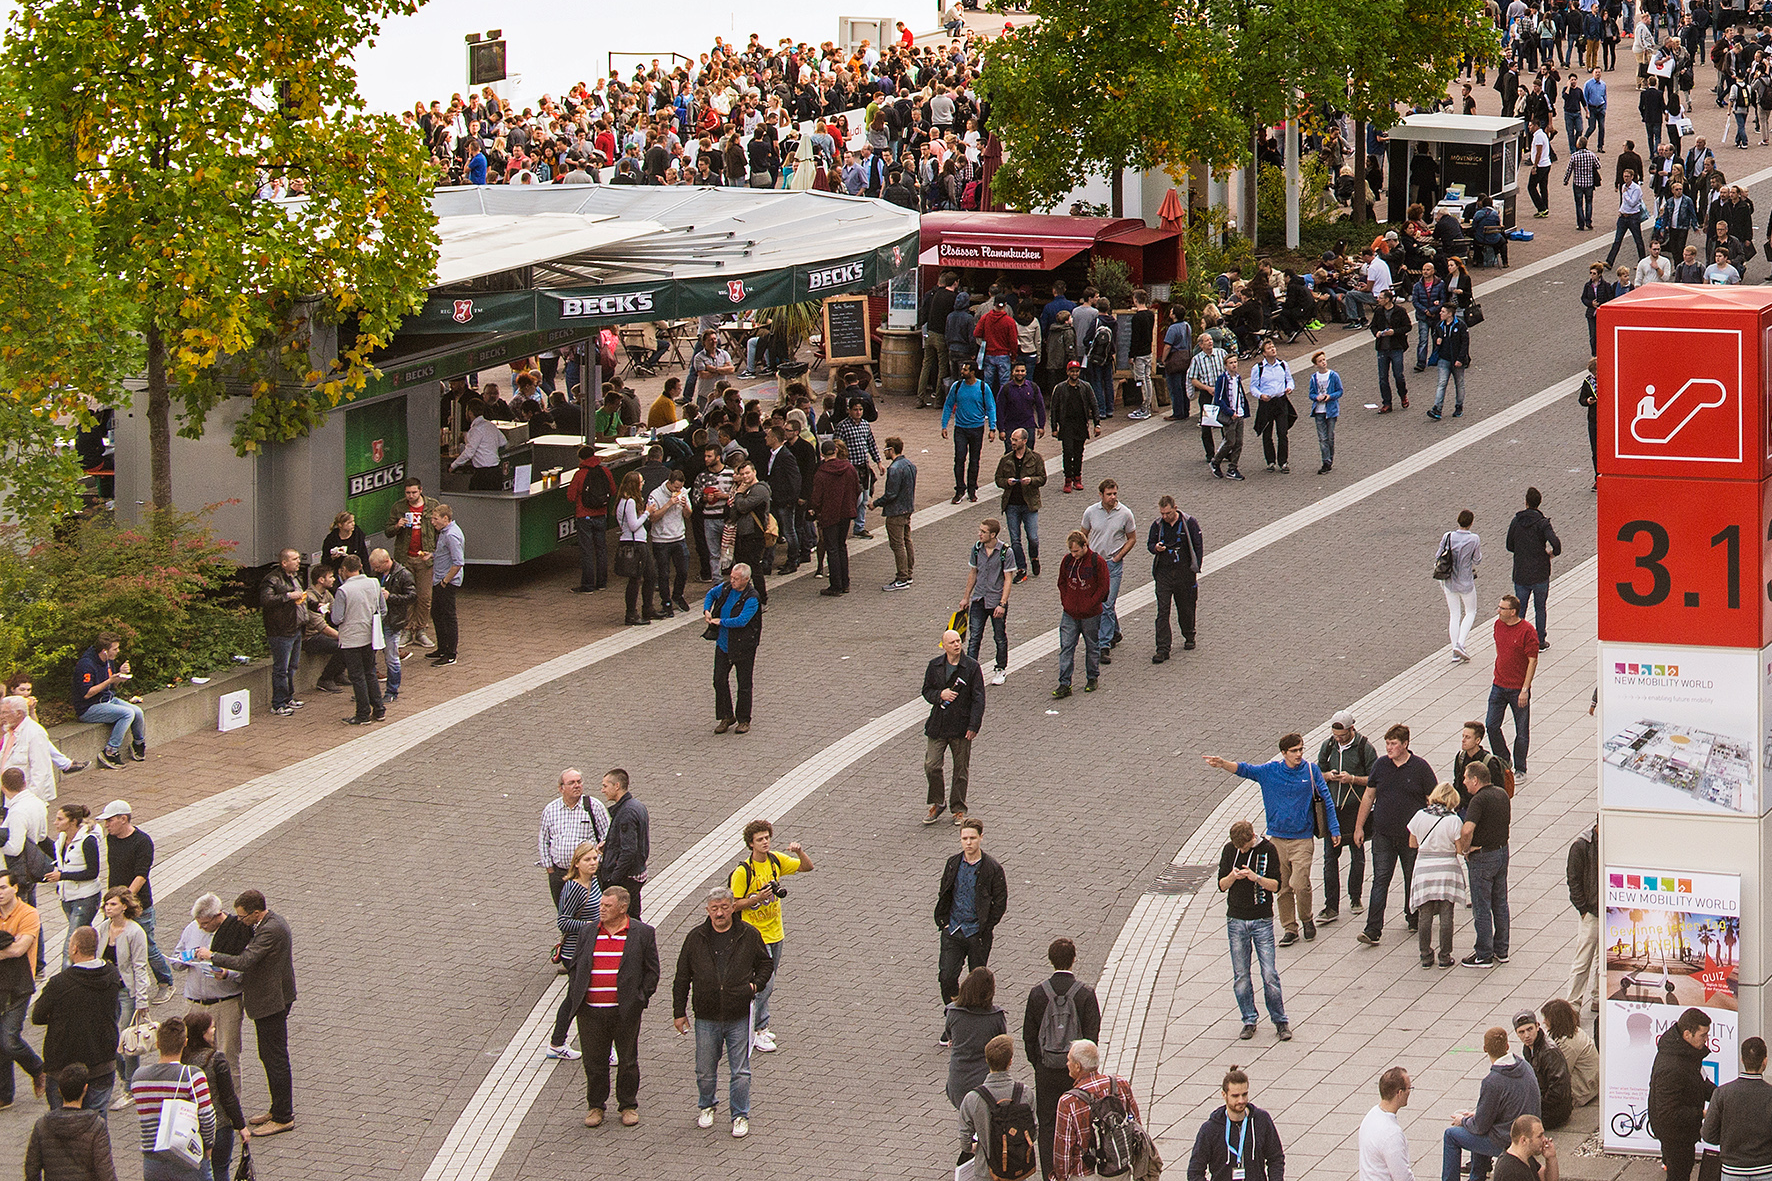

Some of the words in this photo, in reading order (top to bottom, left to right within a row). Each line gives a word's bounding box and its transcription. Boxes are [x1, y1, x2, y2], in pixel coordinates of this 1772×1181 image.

[849, 123, 862, 136] udi
[1450, 154, 1483, 162] MÖVENPICK
[940, 243, 980, 257] Elsässer
[980, 245, 1042, 260] Flammkuchen
[808, 261, 864, 290] BECK'S
[562, 292, 654, 316] BECK'S
[478, 346, 507, 361] BECK'S
[405, 365, 434, 382] BECK'S
[350, 463, 405, 496] BECK'S
[1615, 520, 1741, 610] 3.1
[83, 672, 92, 683] 3
[1614, 676, 1635, 685] NEW
[1637, 677, 1679, 687] MOBILITY
[1681, 679, 1714, 689] WORLD
[1609, 891, 1637, 903] NEW
[1639, 893, 1693, 907] MOBILITY
[1694, 898, 1737, 911] WORLD
[1609, 924, 1663, 938] Gewinne
[1667, 922, 1701, 937] jeden
[1704, 918, 1727, 933] Tag
[1612, 942, 1632, 954] ein
[1635, 937, 1691, 953] CITYBUG
[1702, 971, 1725, 983] QUIZ
